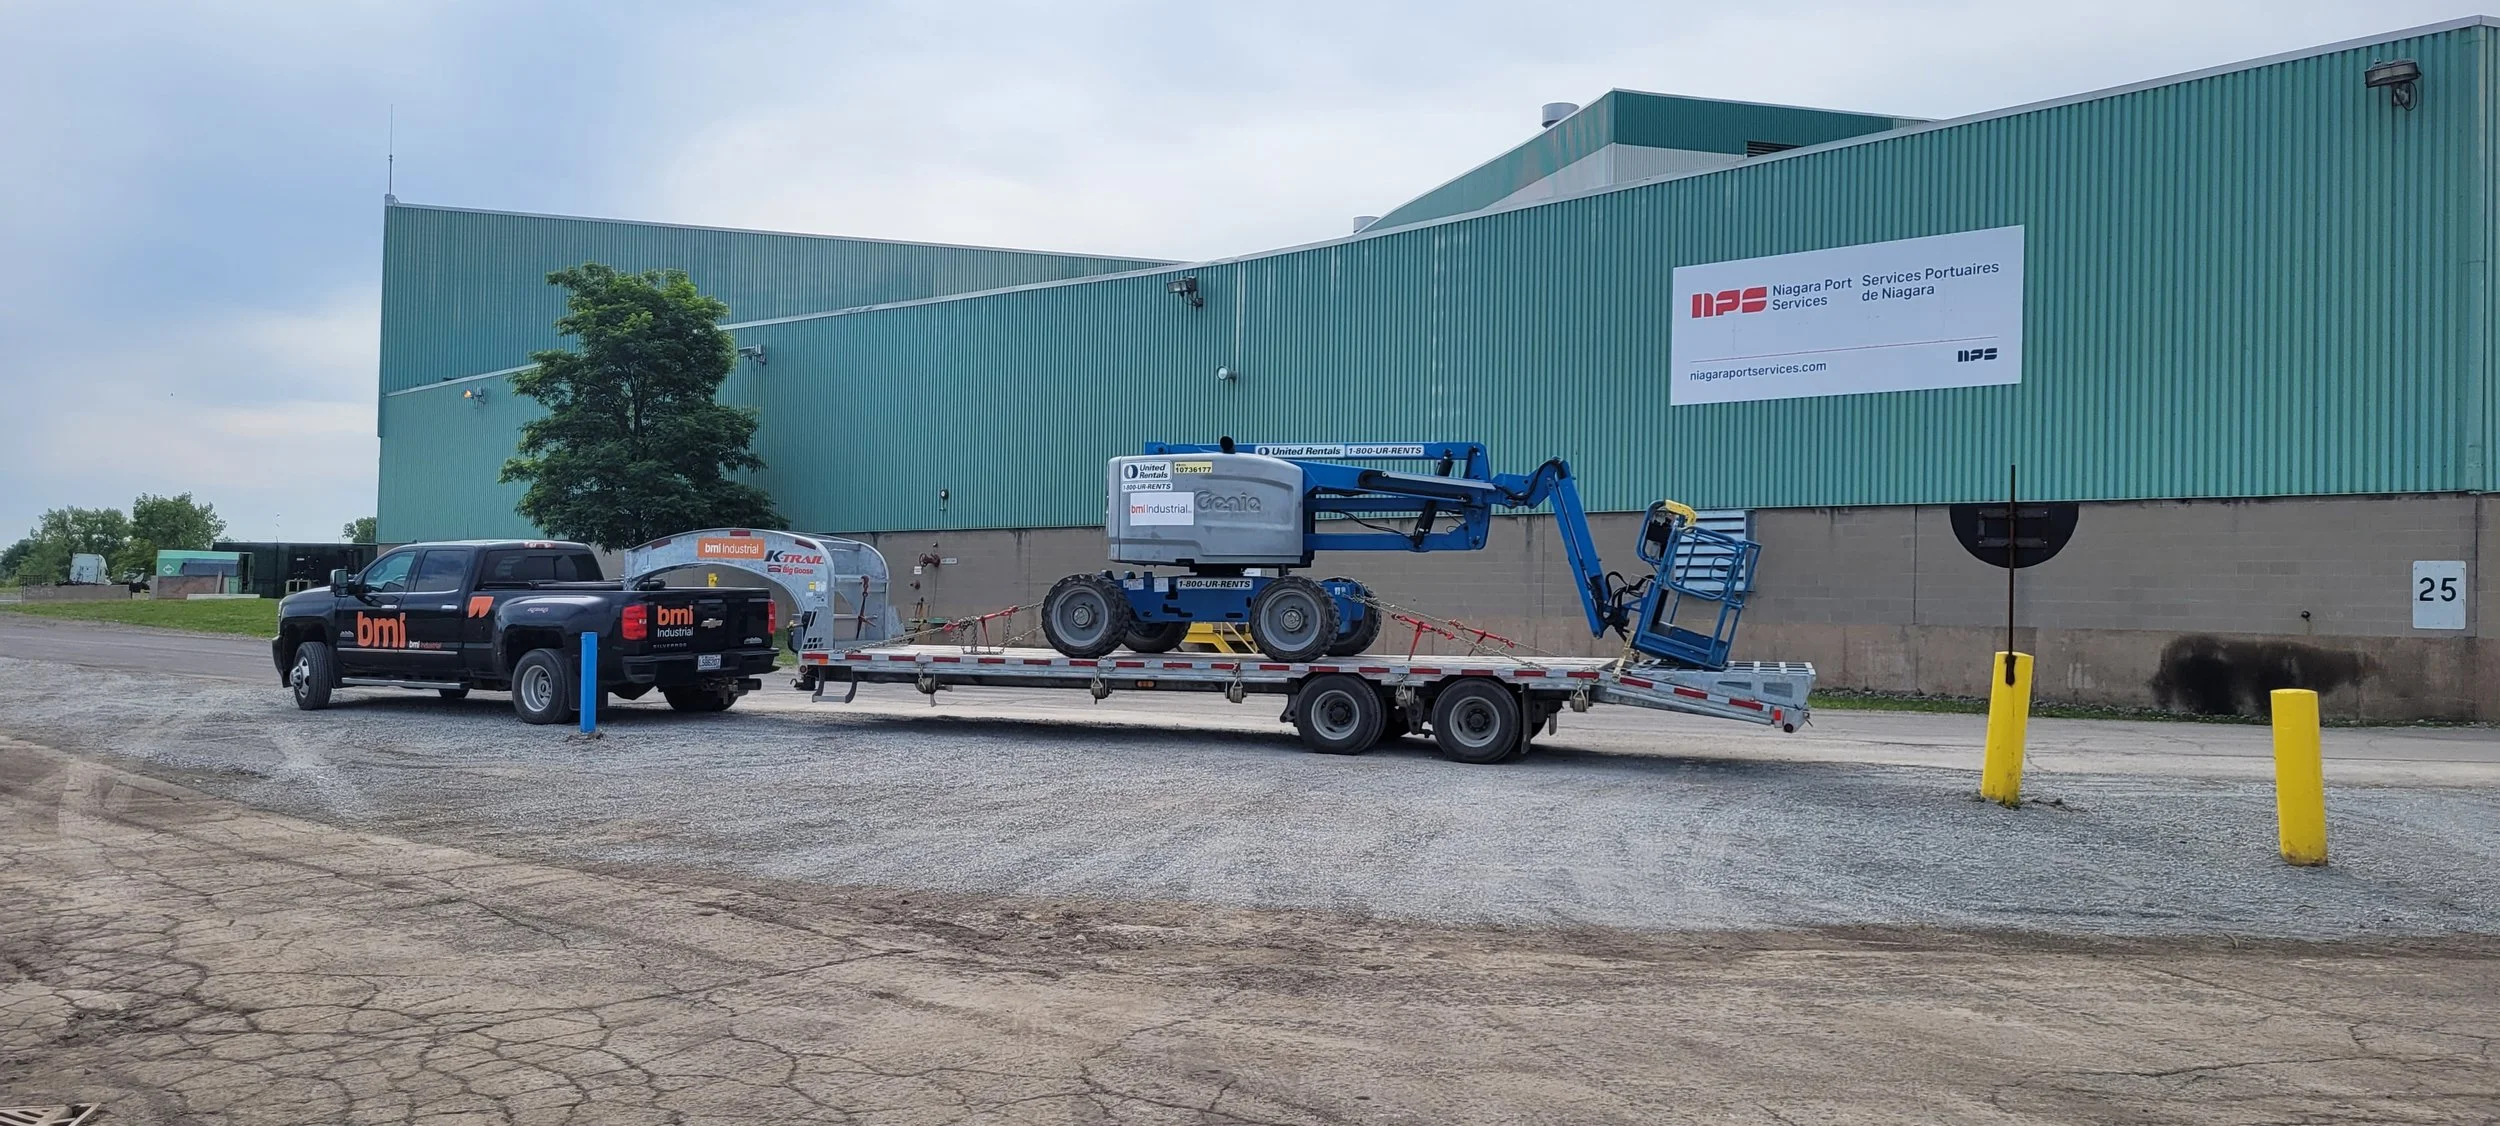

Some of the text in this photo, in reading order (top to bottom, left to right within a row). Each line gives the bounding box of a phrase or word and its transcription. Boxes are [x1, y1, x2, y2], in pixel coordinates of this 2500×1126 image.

[1862, 263, 1999, 286] Services Portuaires
[1772, 277, 1852, 297] Niagara Port
[1861, 285, 1935, 301] de Niagara
[1772, 296, 1828, 311] Services
[1690, 362, 1827, 381] niagaraportservices.com
[1272, 446, 1341, 456] United Rentals
[1348, 446, 1423, 455] 1-800-UR-RENTS
[1139, 464, 1166, 472] United
[1139, 471, 1169, 480] Rentals
[1123, 483, 1171, 491] 1-800-UR-RENTS
[1195, 490, 1261, 512] Genie
[1146, 504, 1188, 514] Industrial
[722, 543, 760, 555] Industrial
[782, 565, 814, 576] Big Goose
[1179, 580, 1251, 588] 1-800-UR-RENTS
[2419, 576, 2457, 602] 25
[657, 604, 694, 626] bmi
[357, 611, 406, 648] bmi
[657, 627, 694, 638] Industrial
